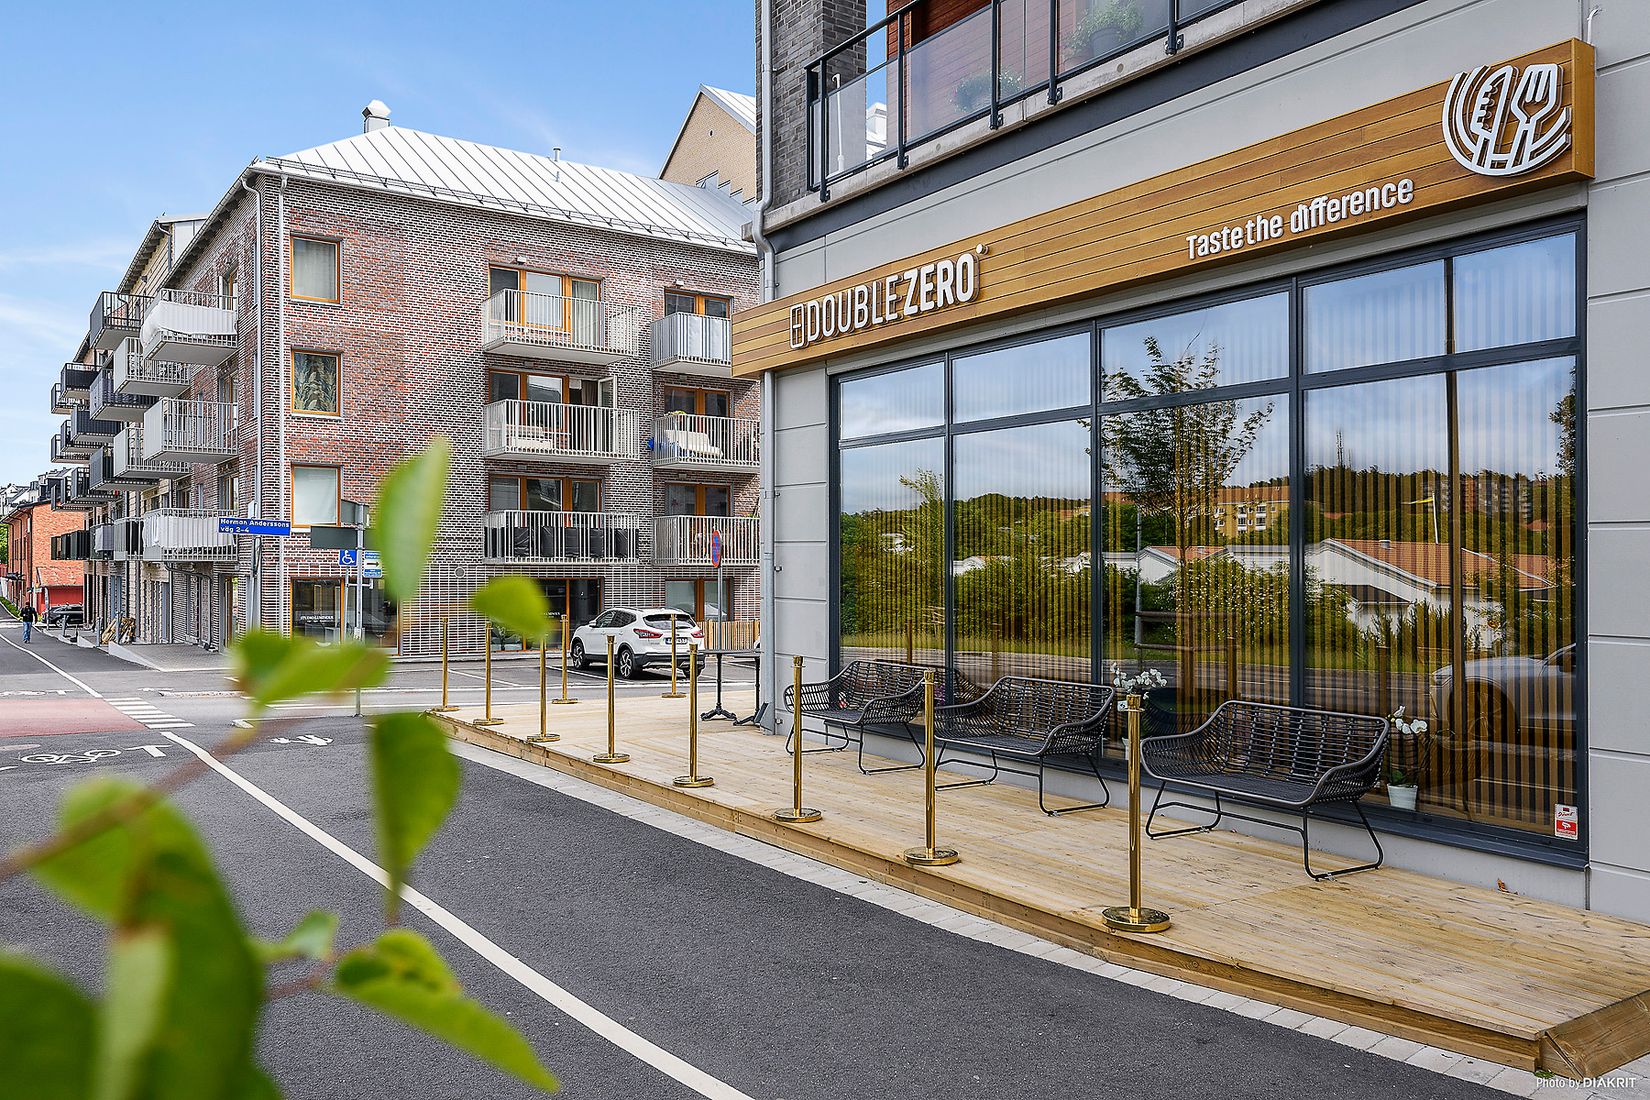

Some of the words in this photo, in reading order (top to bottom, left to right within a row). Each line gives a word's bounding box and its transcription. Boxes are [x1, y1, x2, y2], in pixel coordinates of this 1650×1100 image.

[1186, 223, 1243, 259] Taste
[1245, 214, 1284, 245] the
[1290, 178, 1415, 232] difference
[249, 520, 290, 528] Anderssons
